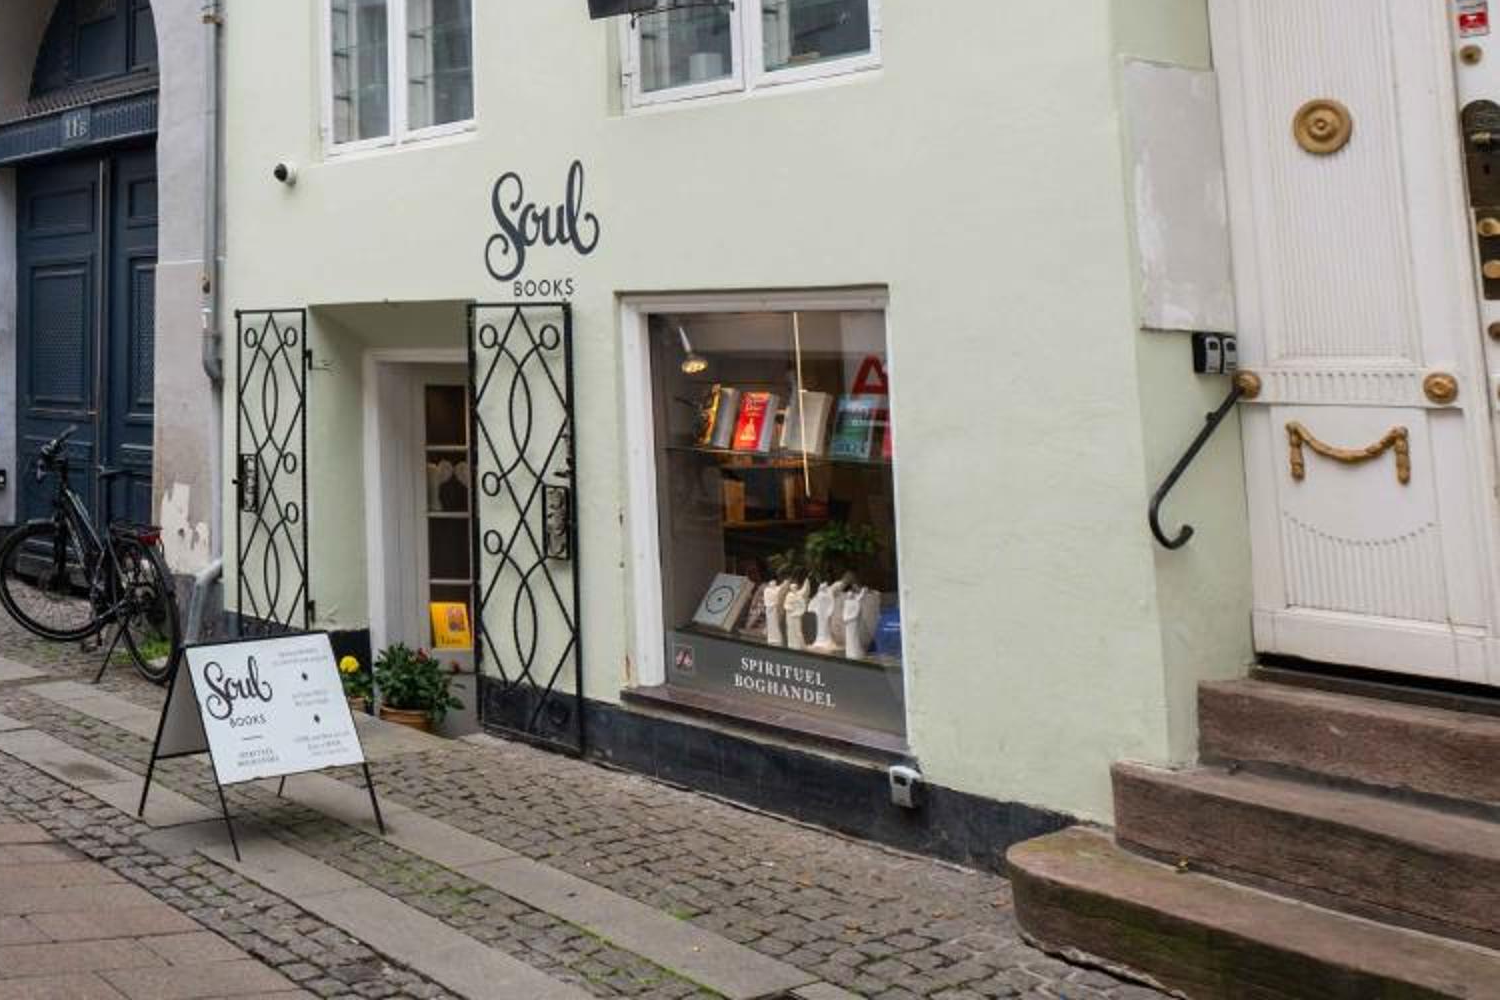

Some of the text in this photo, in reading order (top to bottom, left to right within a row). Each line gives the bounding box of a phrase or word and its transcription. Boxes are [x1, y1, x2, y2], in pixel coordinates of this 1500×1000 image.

[485, 159, 600, 282] Soul
[513, 279, 575, 297] BOOKS
[203, 655, 273, 720] Soul
[740, 657, 826, 687] SPIRITUEL
[734, 674, 836, 708] BOGHANDEL
[229, 713, 267, 729] BOOKS
